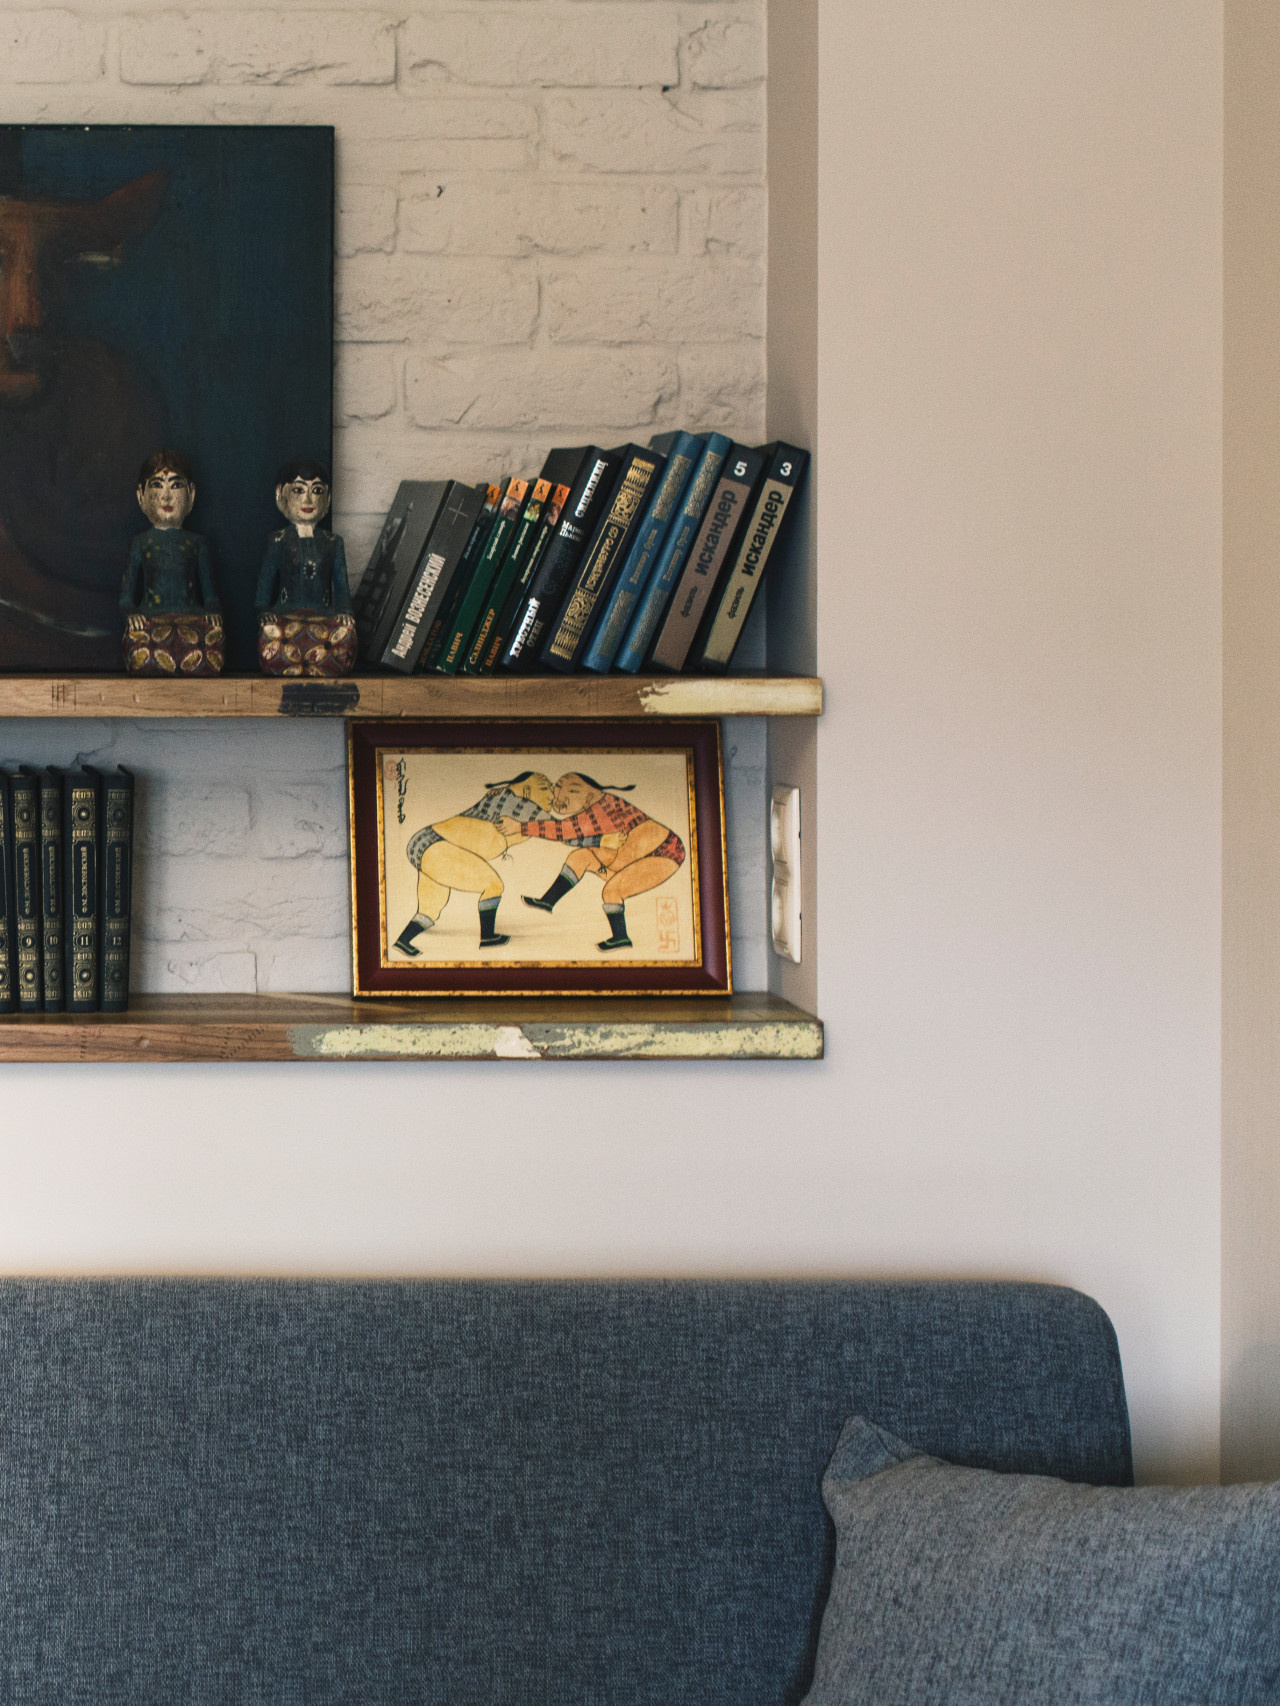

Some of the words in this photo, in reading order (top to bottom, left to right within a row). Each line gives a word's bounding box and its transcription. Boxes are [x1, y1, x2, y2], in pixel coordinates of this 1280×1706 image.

[733, 461, 748, 477] 5
[780, 462, 793, 477] 3
[392, 623, 417, 659] Андрей
[406, 553, 446, 624] ВОЗНЕСЕНСКИЙ
[470, 608, 496, 665] СЭЛИНДЖЕР
[527, 619, 544, 647] ОТЕЦ
[447, 632, 463, 663] ПАВИЧ
[486, 636, 502, 667] ПАВИЧ
[26, 938, 32, 947] 9
[49, 936, 59, 945] 10
[81, 936, 89, 946] 11
[112, 937, 123, 946] 12
